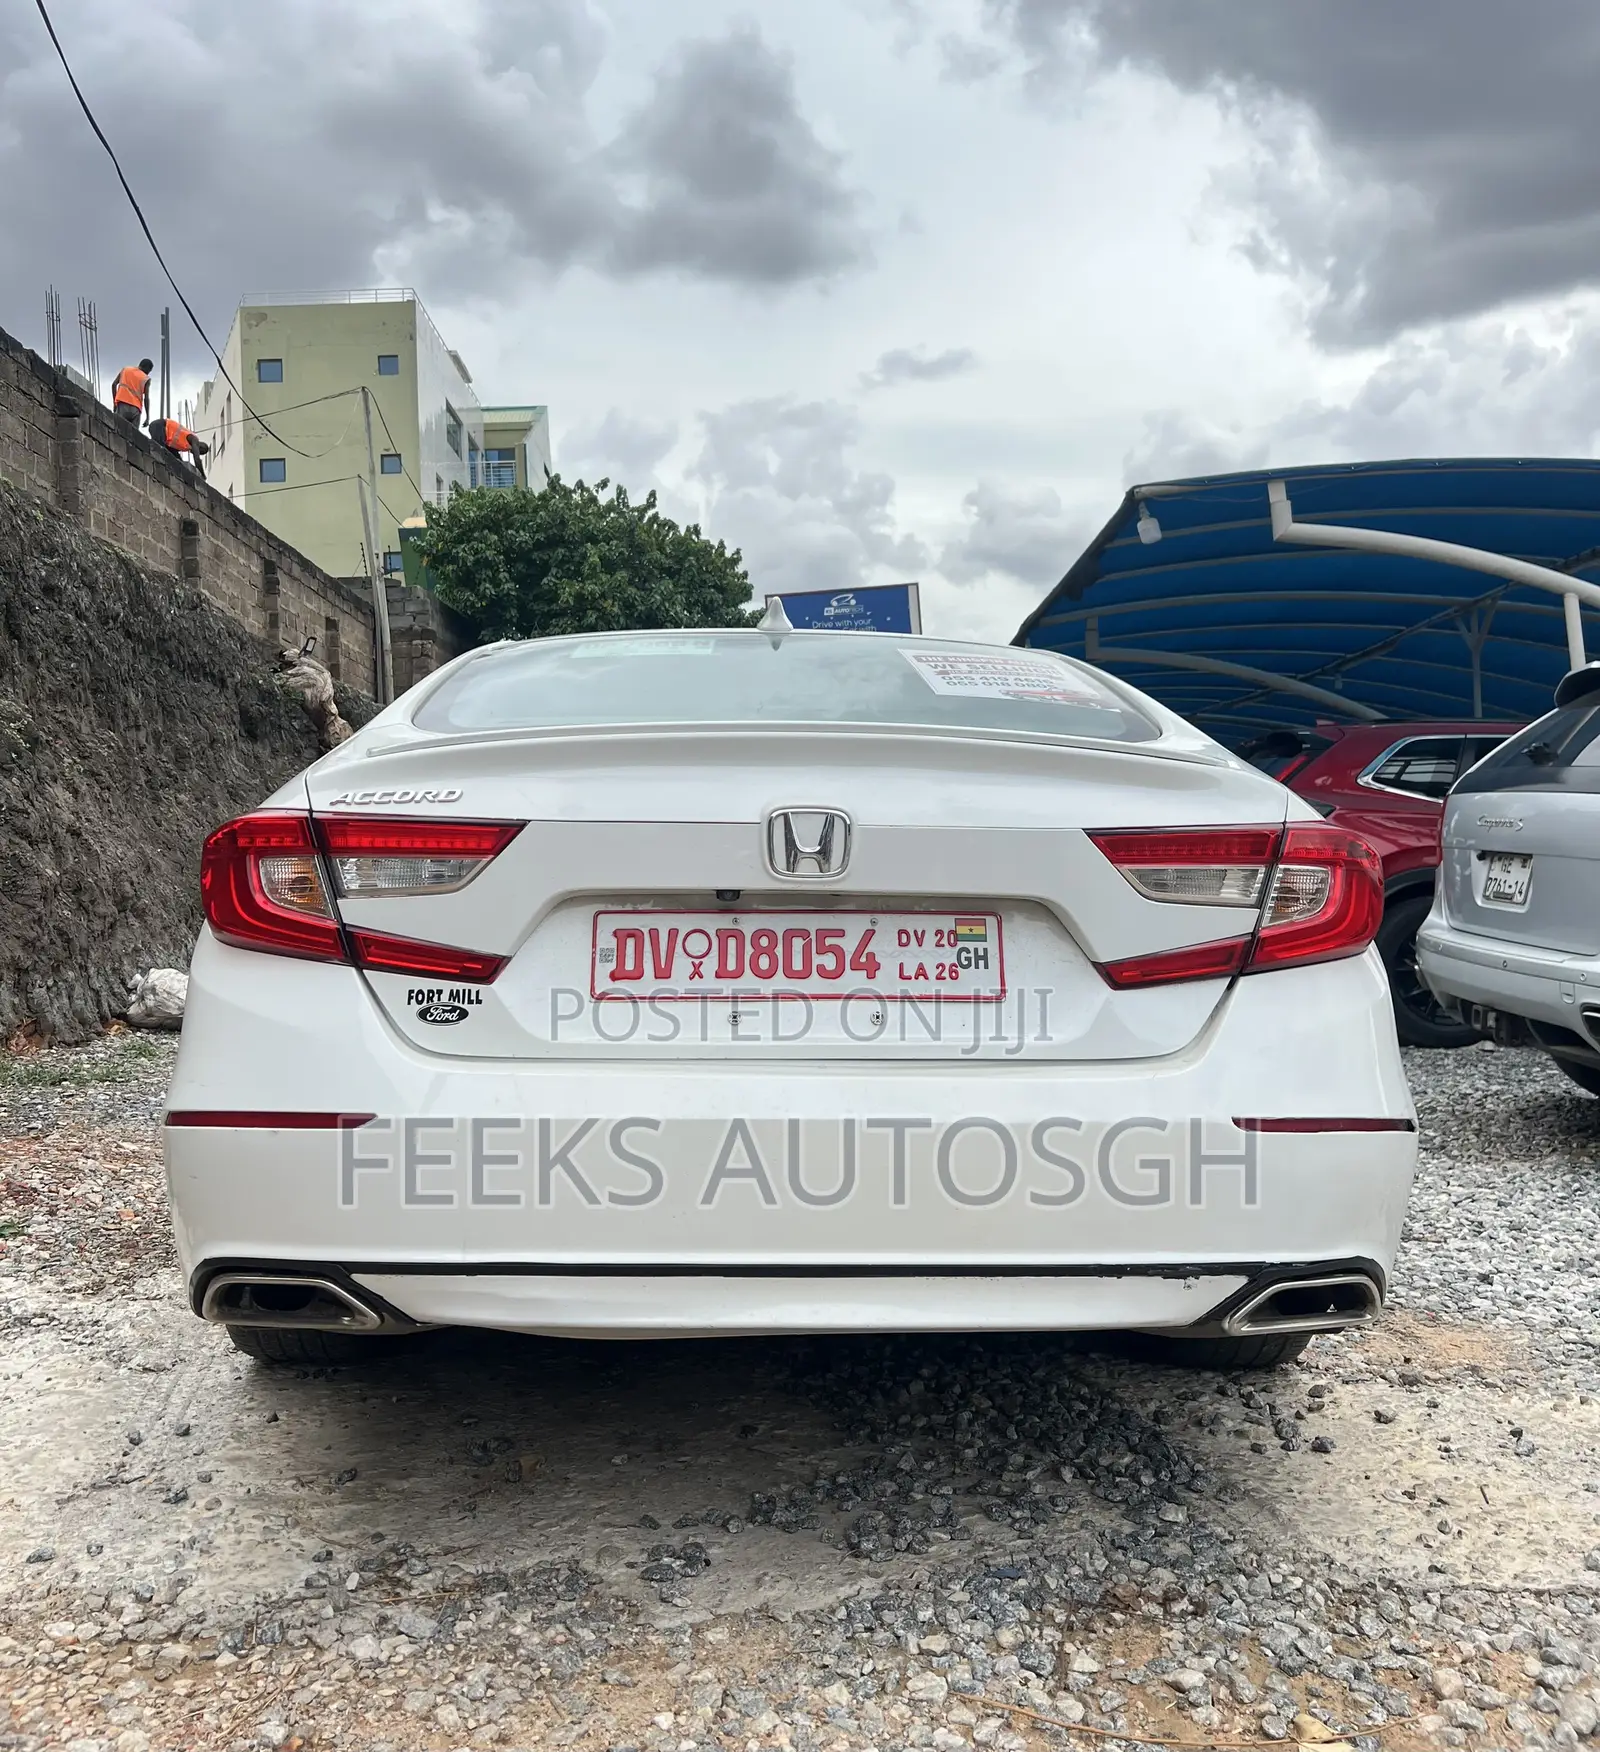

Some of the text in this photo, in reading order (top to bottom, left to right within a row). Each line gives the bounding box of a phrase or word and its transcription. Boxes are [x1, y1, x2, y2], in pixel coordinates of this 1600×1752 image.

[812, 621, 834, 629] Drive
[854, 619, 872, 627] your
[329, 789, 464, 806] ACCORD
[897, 929, 958, 947] DV 20
[956, 947, 989, 970] GH
[898, 962, 960, 981] LA 26
[407, 989, 483, 1006] FORT MILL
[426, 1006, 460, 1021] Ford
